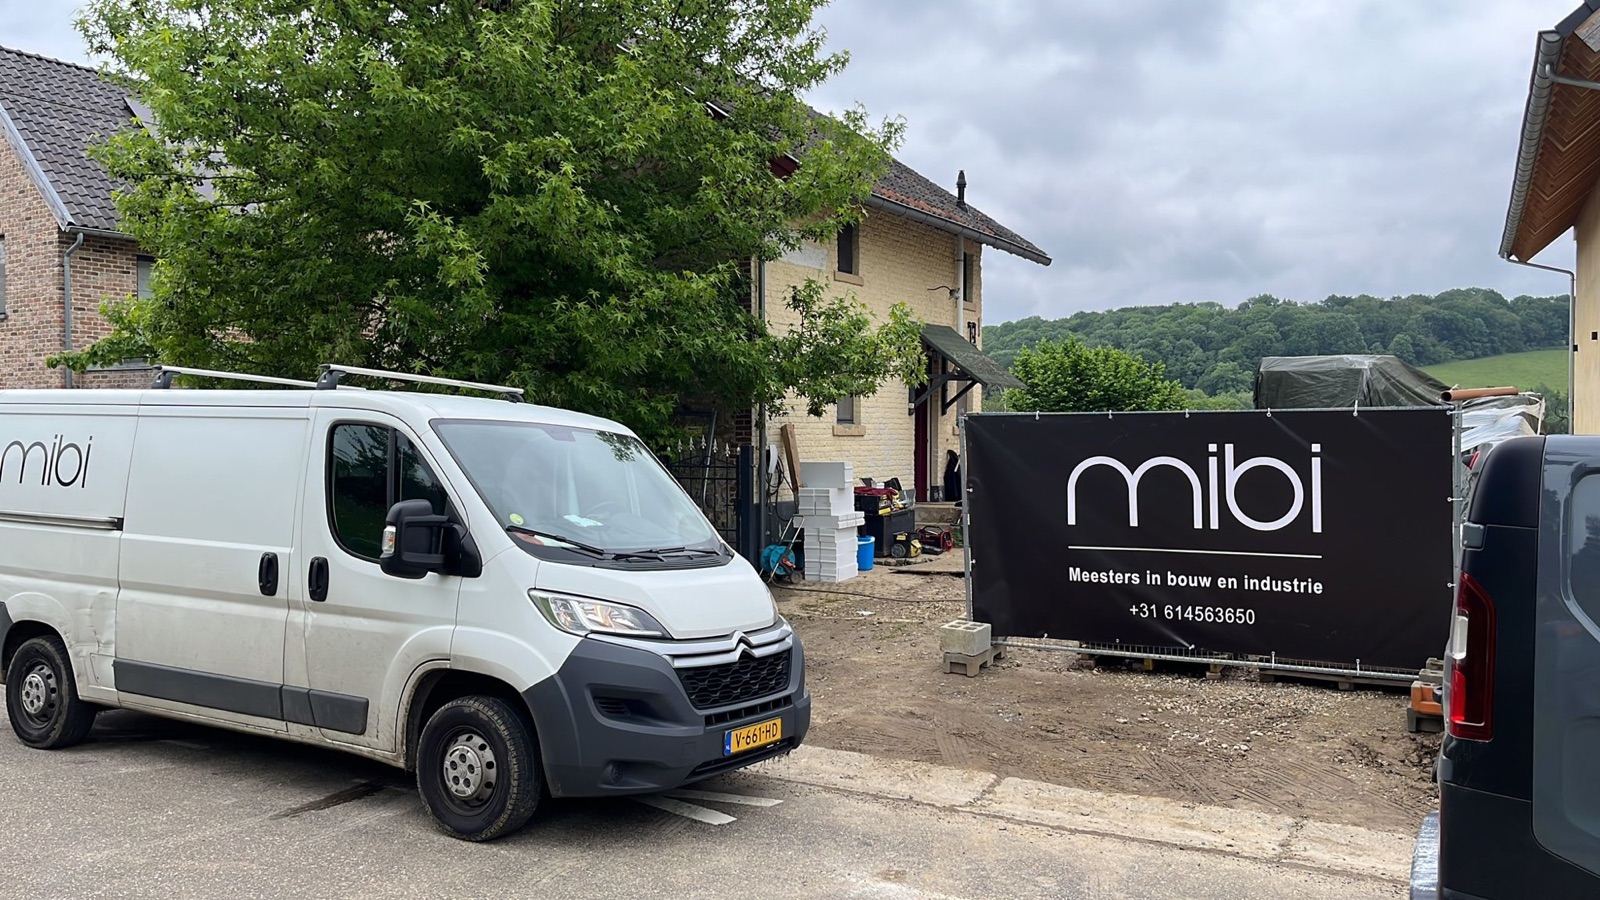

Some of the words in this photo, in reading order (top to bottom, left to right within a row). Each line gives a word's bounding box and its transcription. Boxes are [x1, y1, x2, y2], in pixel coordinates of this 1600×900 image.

[0, 433, 93, 488] mibi
[1067, 443, 1322, 533] mibi
[1068, 566, 1141, 585] Meesters
[1146, 570, 1161, 586] in
[1167, 571, 1212, 588] bouw
[1217, 576, 1238, 590] en
[1244, 574, 1323, 594] industrie
[1129, 603, 1157, 618] +31
[1164, 604, 1256, 625] 614563650
[735, 722, 778, 748] V-661-HD
